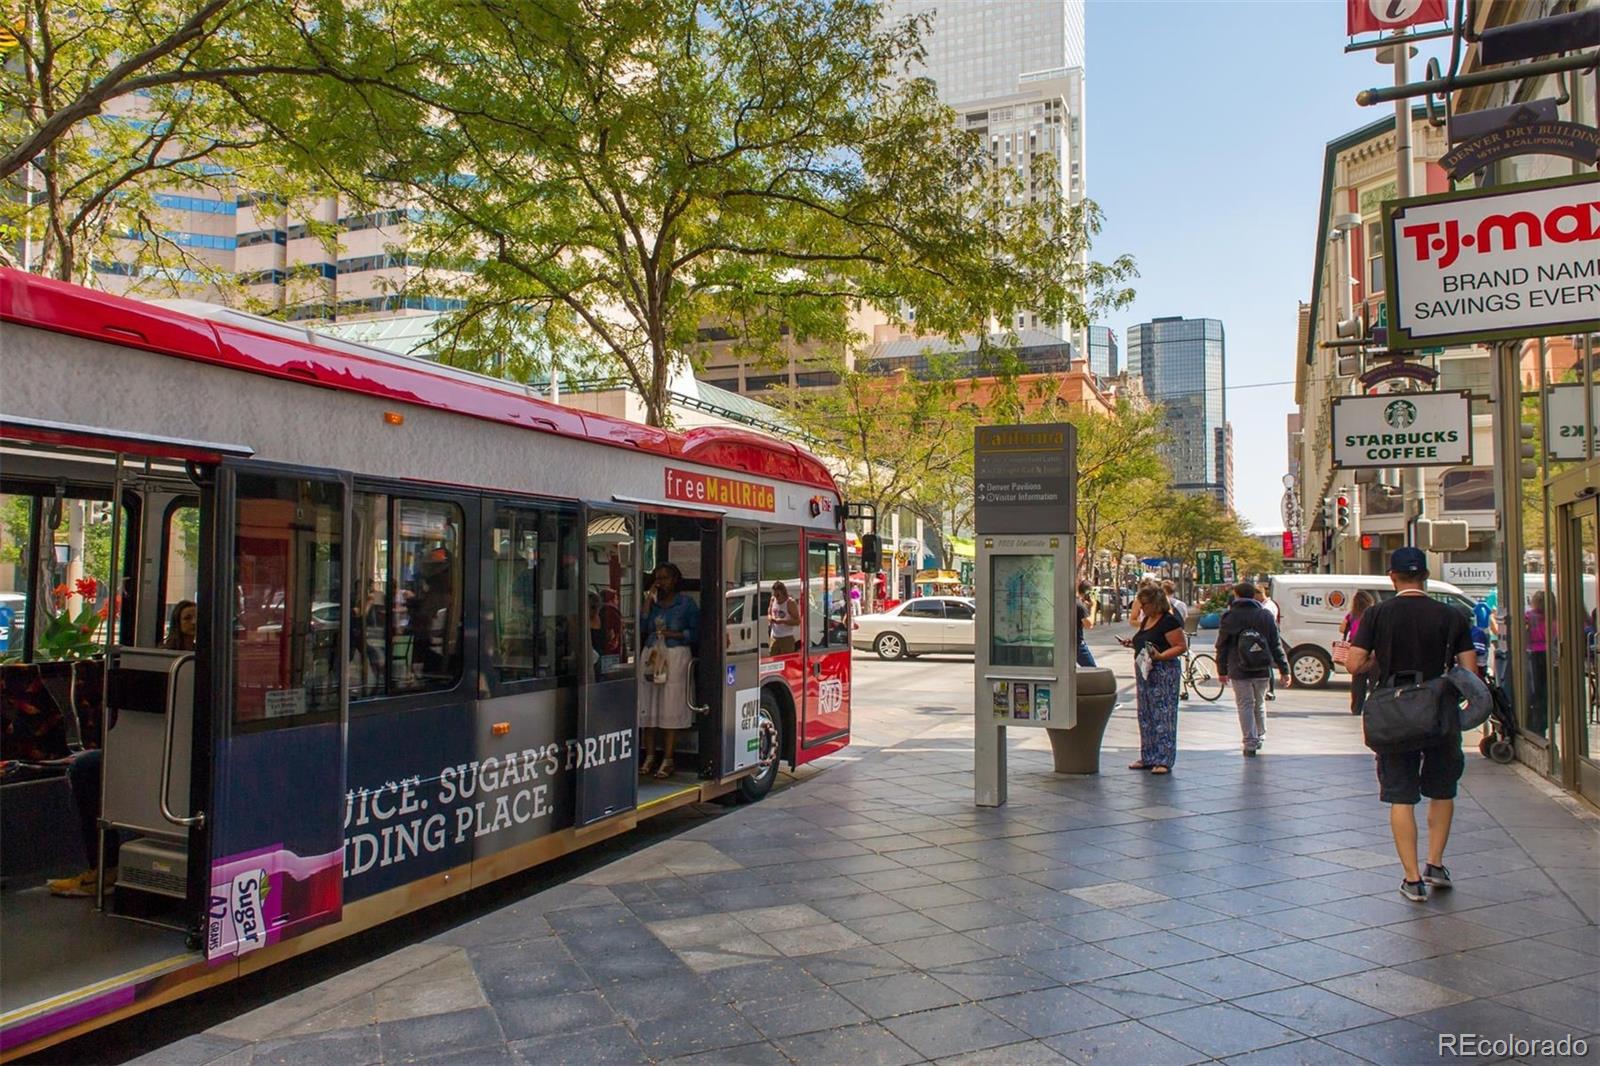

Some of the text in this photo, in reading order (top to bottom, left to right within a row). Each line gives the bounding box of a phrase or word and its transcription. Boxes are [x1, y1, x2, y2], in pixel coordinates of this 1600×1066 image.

[1448, 133, 1502, 166] DENVER
[1506, 126, 1537, 138] DRY
[1513, 137, 1575, 148] CALIFORNIA
[1443, 258, 1600, 293] BRAND NAM
[1414, 292, 1521, 320] SAVINGS
[1345, 430, 1458, 447] STARBUCKS
[1366, 446, 1437, 460] COFFEE
[987, 483, 1009, 491] Denver
[1018, 492, 1058, 501] Information
[1301, 595, 1322, 607] Lite
[817, 679, 843, 715] RTD
[438, 742, 559, 804] SUGAR'S
[454, 784, 554, 844] PLACE.
[235, 879, 259, 943] Sugar
[209, 921, 221, 951] GRAMS
